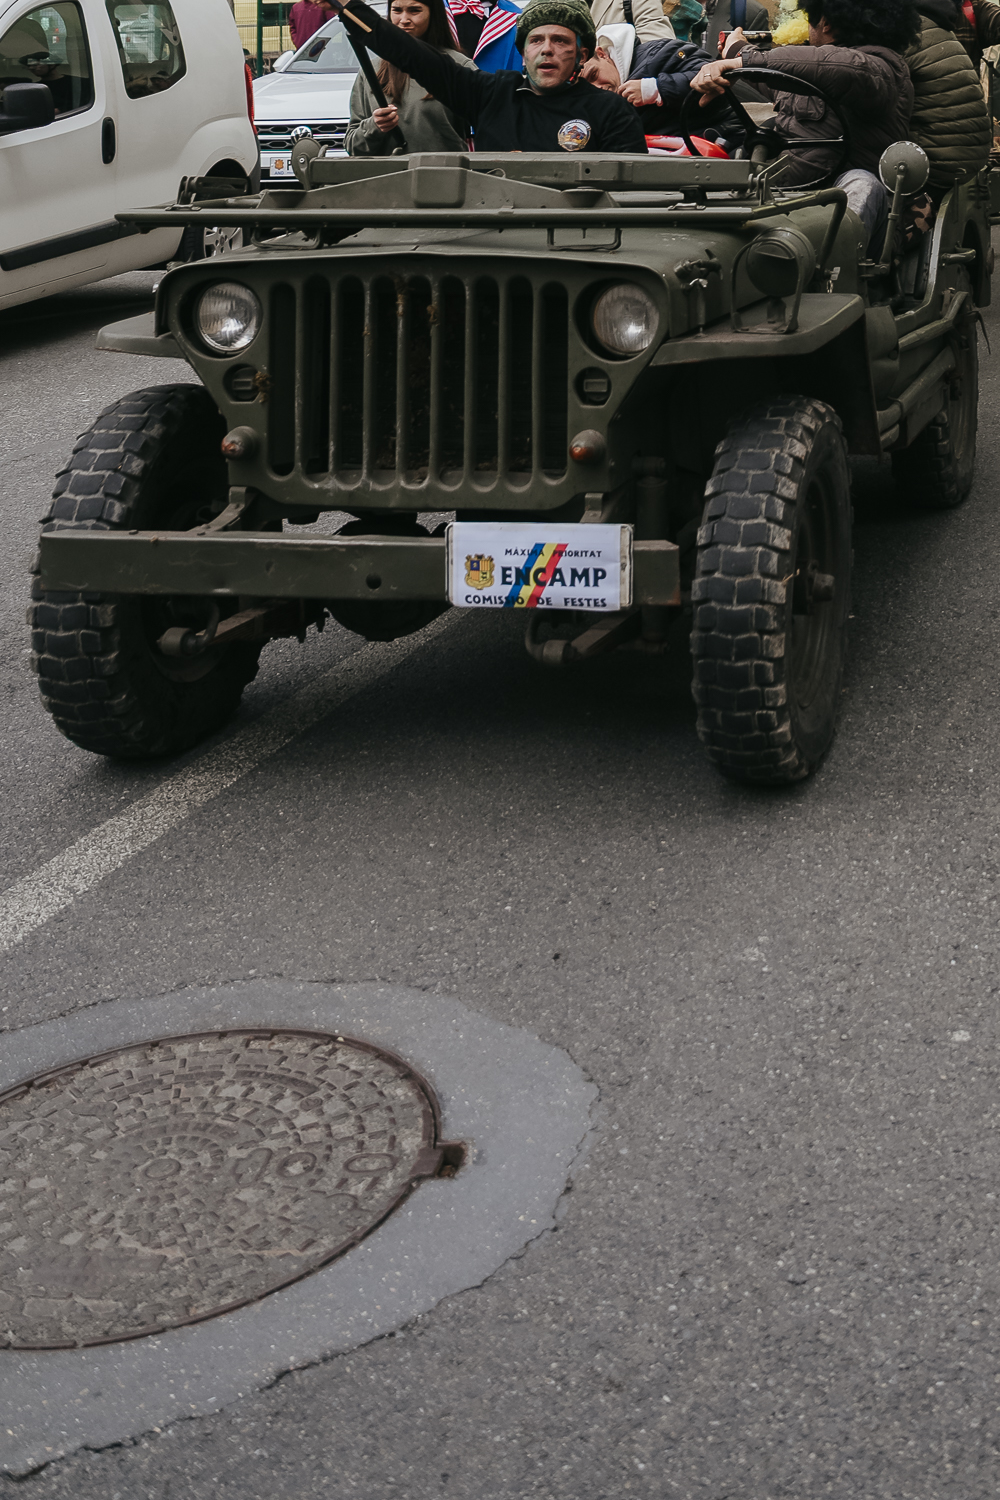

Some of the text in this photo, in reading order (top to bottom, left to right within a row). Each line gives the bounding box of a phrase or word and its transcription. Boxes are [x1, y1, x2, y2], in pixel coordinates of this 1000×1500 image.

[552, 550, 602, 558] PRIORITAT
[501, 566, 607, 587] ENCAMP
[465, 594, 607, 607] COMISSIÓ DE FESTES
